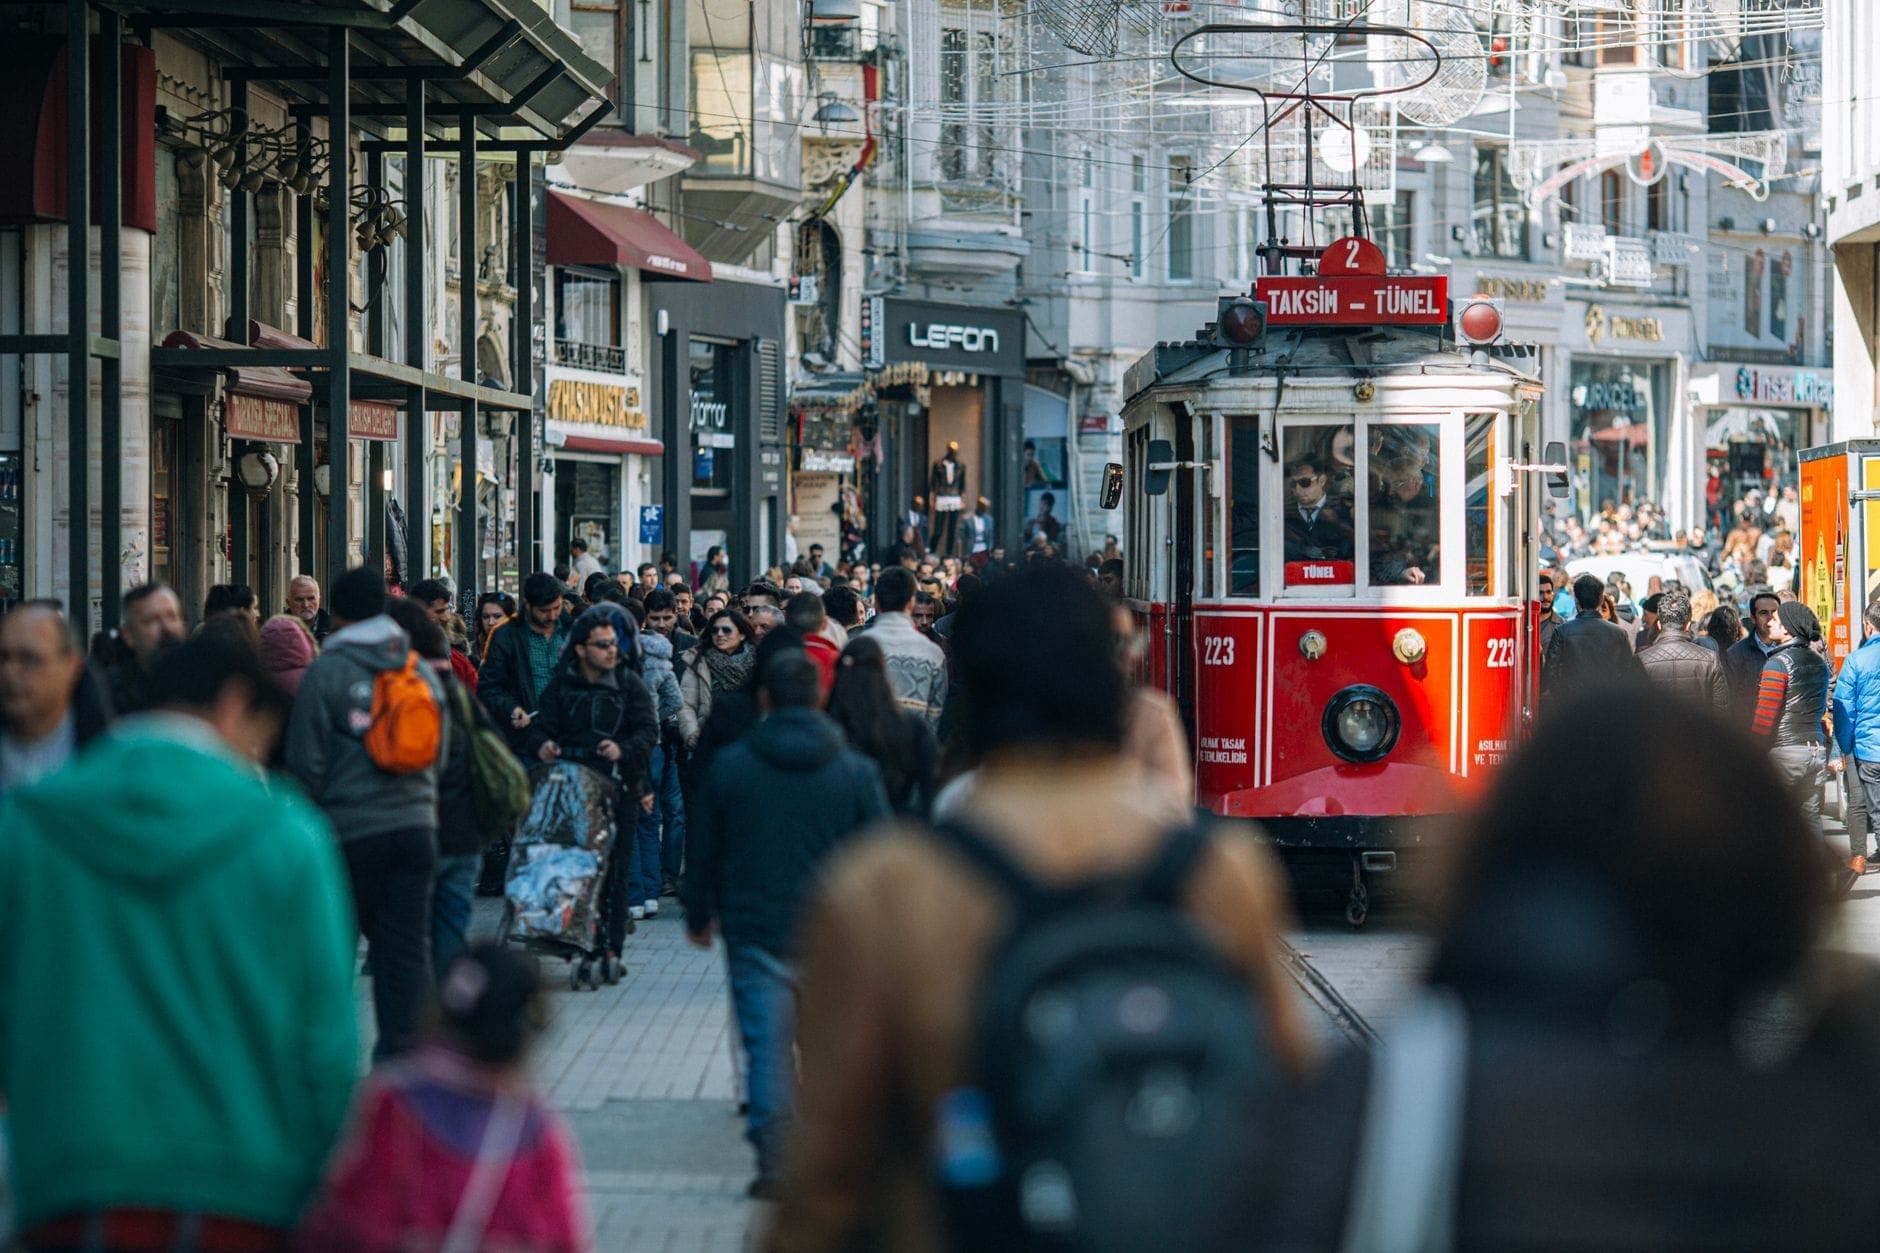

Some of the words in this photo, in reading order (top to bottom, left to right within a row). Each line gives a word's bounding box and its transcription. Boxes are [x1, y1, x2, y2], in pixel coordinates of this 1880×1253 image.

[1345, 239, 1360, 269] 2
[1373, 285, 1441, 315] TÜNEL
[231, 396, 263, 434] TURKISH
[264, 401, 294, 438] SPECIAL
[350, 405, 372, 434] URKISH
[1302, 564, 1336, 579] TÜNEL
[1204, 636, 1236, 666] 223
[1486, 638, 1515, 668] 223
[1474, 753, 1486, 766] VE
